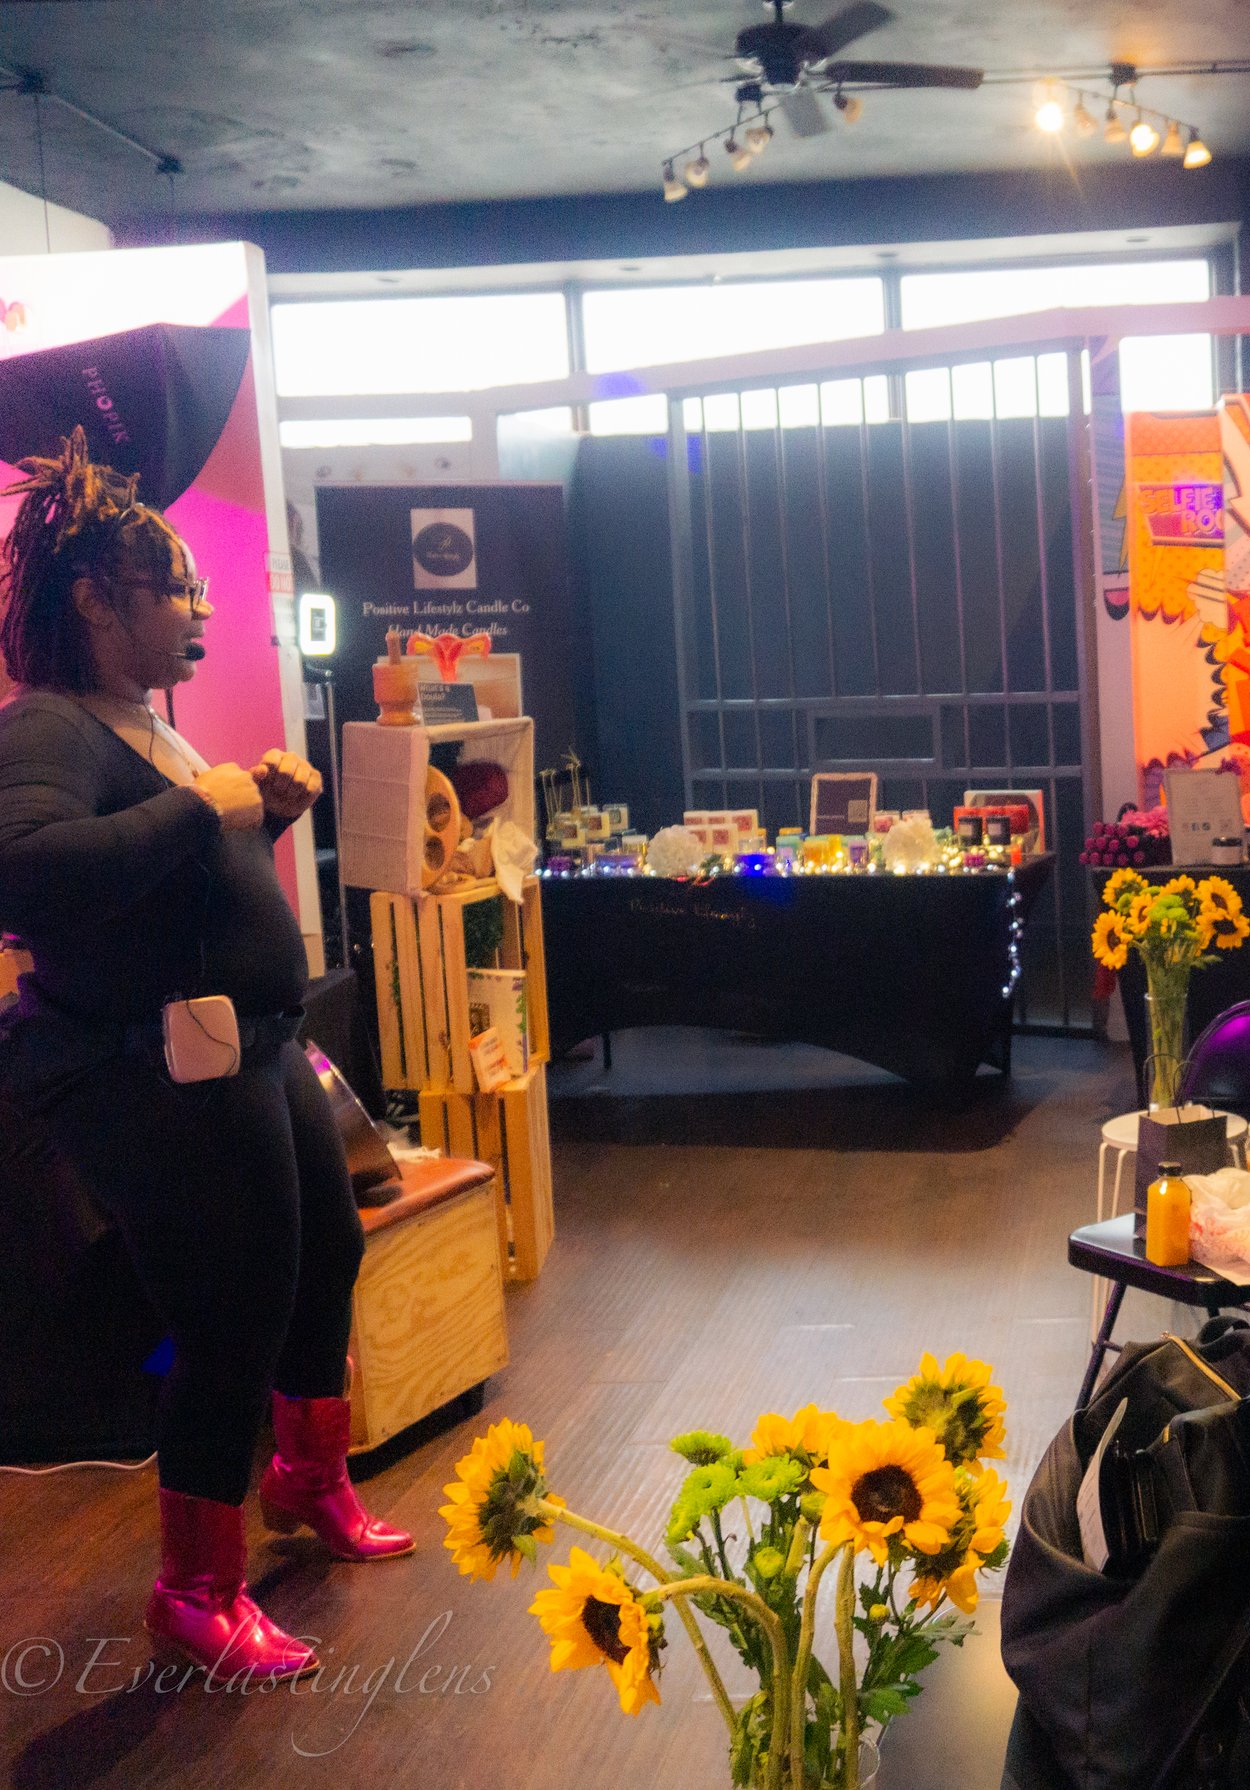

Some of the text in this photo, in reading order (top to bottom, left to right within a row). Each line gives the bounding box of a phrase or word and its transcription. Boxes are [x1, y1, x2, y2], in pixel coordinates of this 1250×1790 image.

[1140, 487, 1216, 515] SELFIE
[362, 599, 530, 616] Positive Lifestylz Candle Co
[425, 623, 458, 637] Made
[462, 622, 508, 637] Candles
